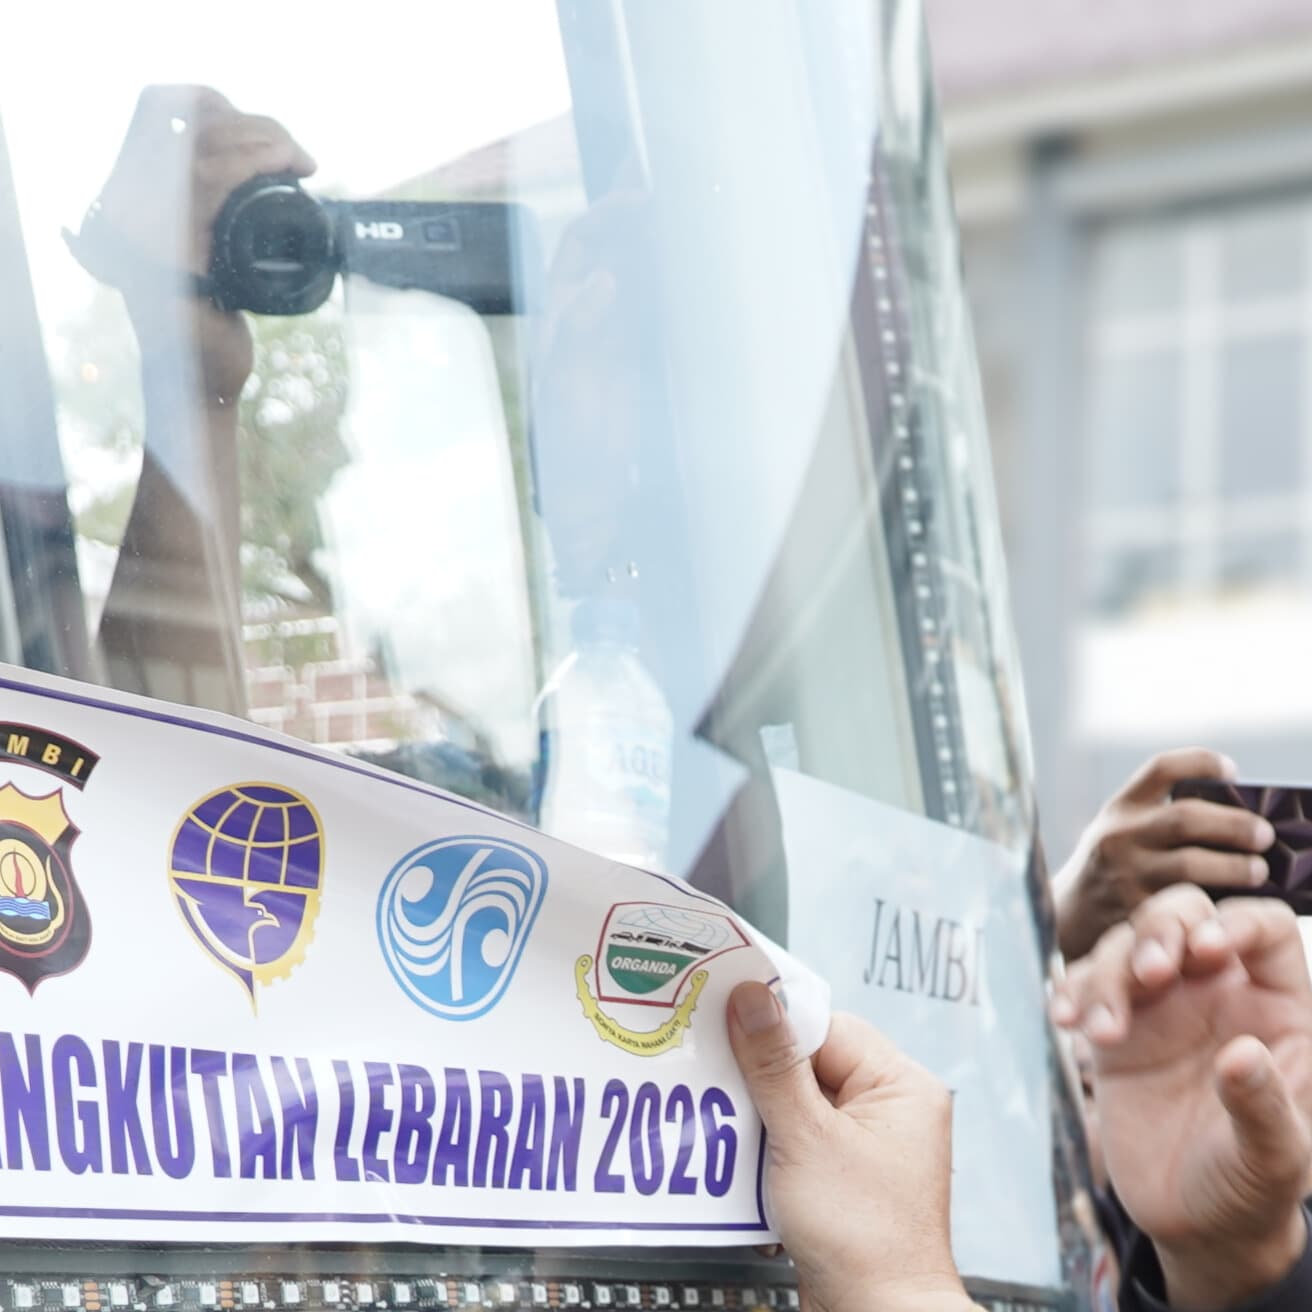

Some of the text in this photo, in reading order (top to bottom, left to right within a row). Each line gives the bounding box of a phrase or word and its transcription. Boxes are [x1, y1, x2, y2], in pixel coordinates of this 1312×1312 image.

[355, 221, 403, 241] HD
[611, 956, 677, 976] ORGANDA
[863, 898, 985, 1007] JAMBI
[333, 1063, 586, 1192] LEBARAN
[593, 1080, 737, 1198] 2026
